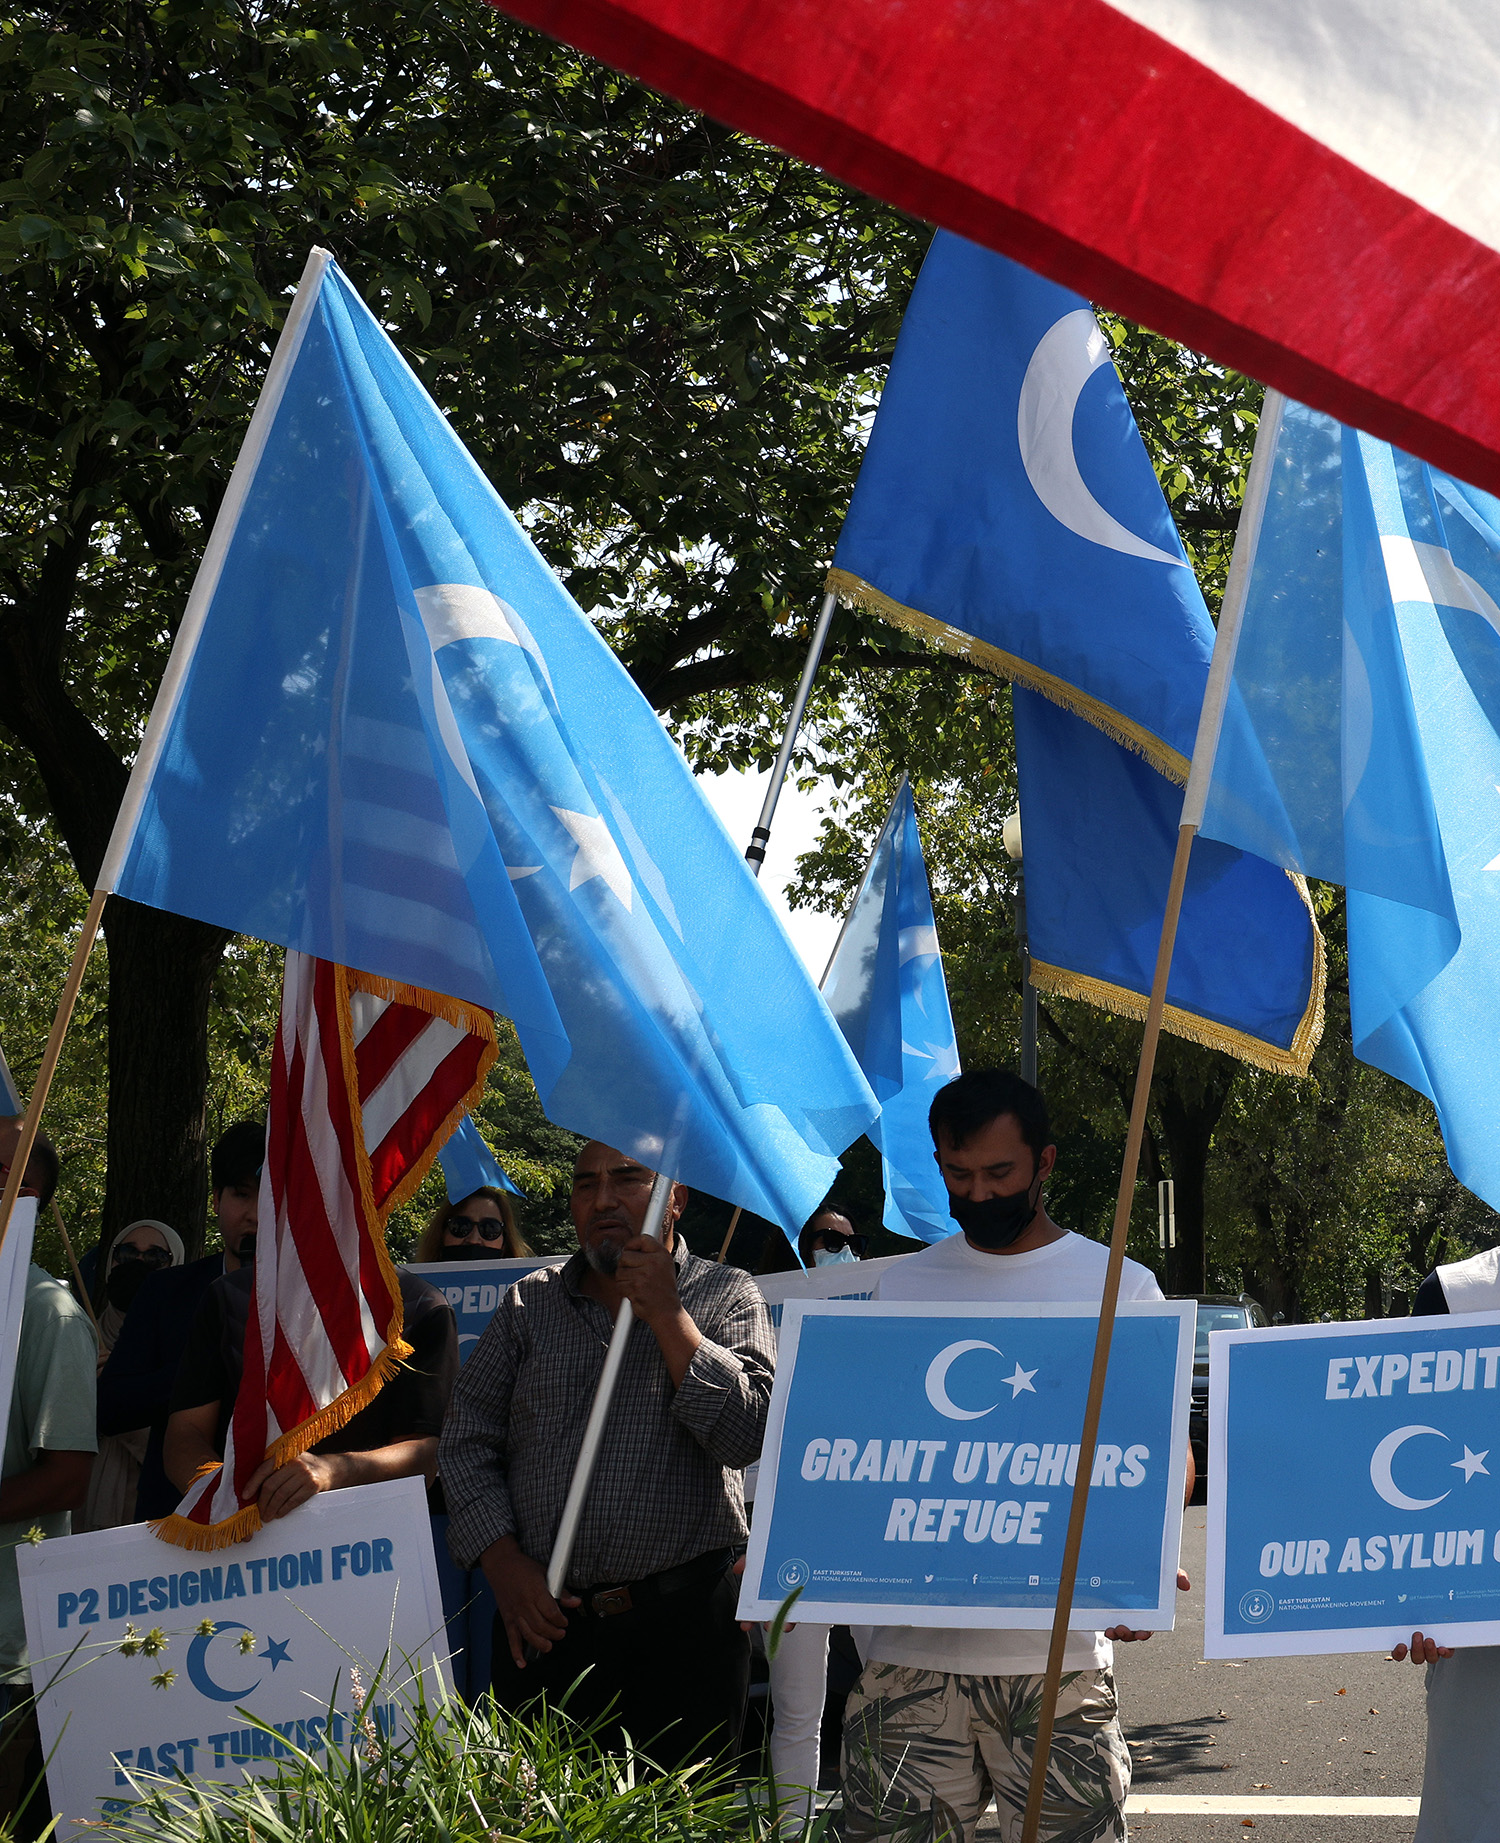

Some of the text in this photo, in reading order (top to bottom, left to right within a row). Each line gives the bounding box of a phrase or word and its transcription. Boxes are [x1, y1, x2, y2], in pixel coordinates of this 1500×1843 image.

[800, 1438, 947, 1482] GRANT
[884, 1498, 1050, 1544] REFUGE
[1259, 1539, 1331, 1578] OUR
[1337, 1529, 1485, 1574] ASYLUM
[57, 1537, 394, 1629] P2 DESIGNATION FOR
[113, 1738, 200, 1786] EAST
